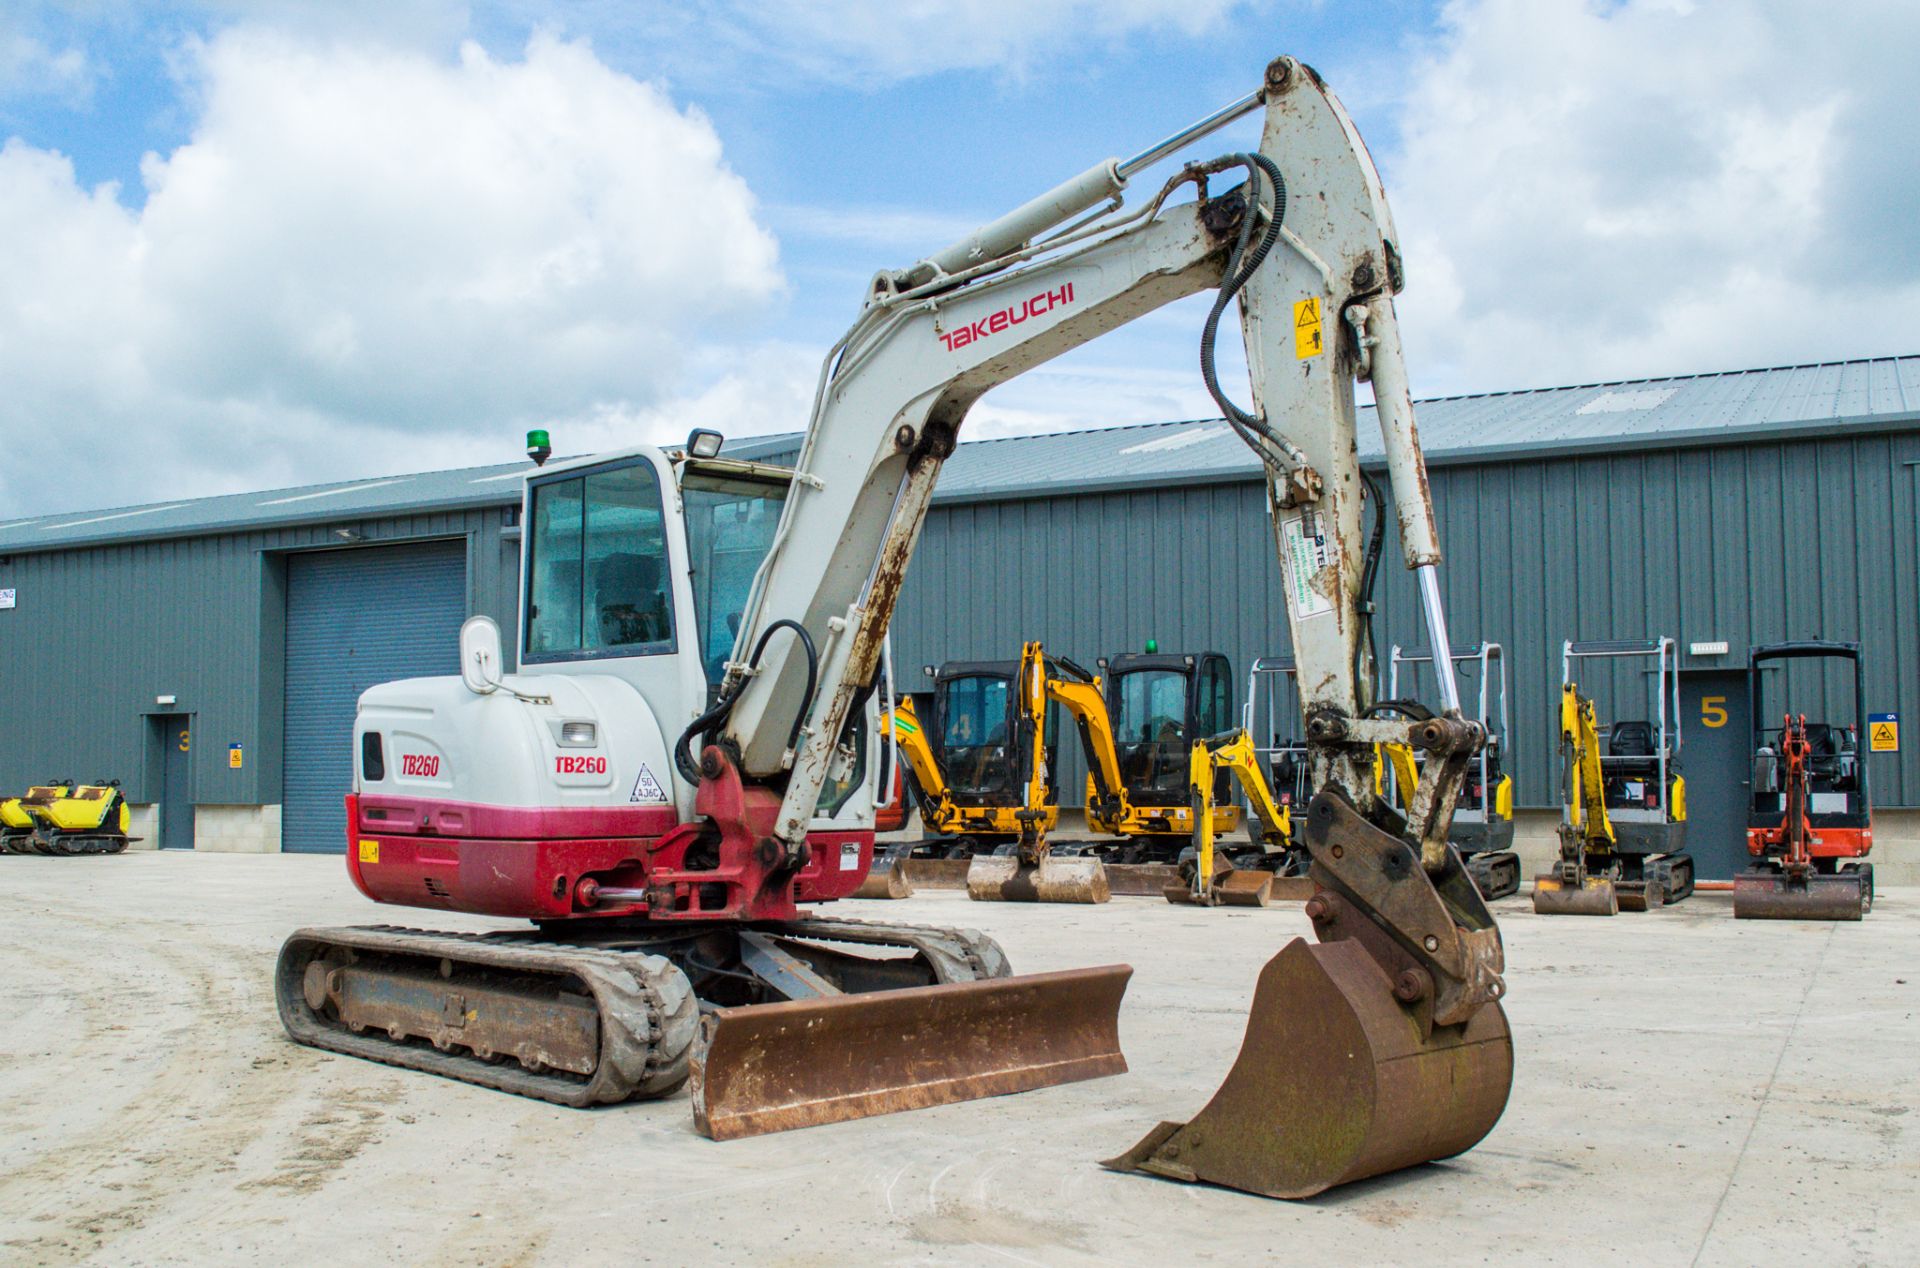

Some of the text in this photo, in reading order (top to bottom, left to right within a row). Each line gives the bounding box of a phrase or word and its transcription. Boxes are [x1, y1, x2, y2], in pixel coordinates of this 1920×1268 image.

[1702, 696, 1728, 727] 5
[179, 731, 190, 751] 3
[402, 754, 440, 777] TB260
[555, 756, 606, 774] TB260
